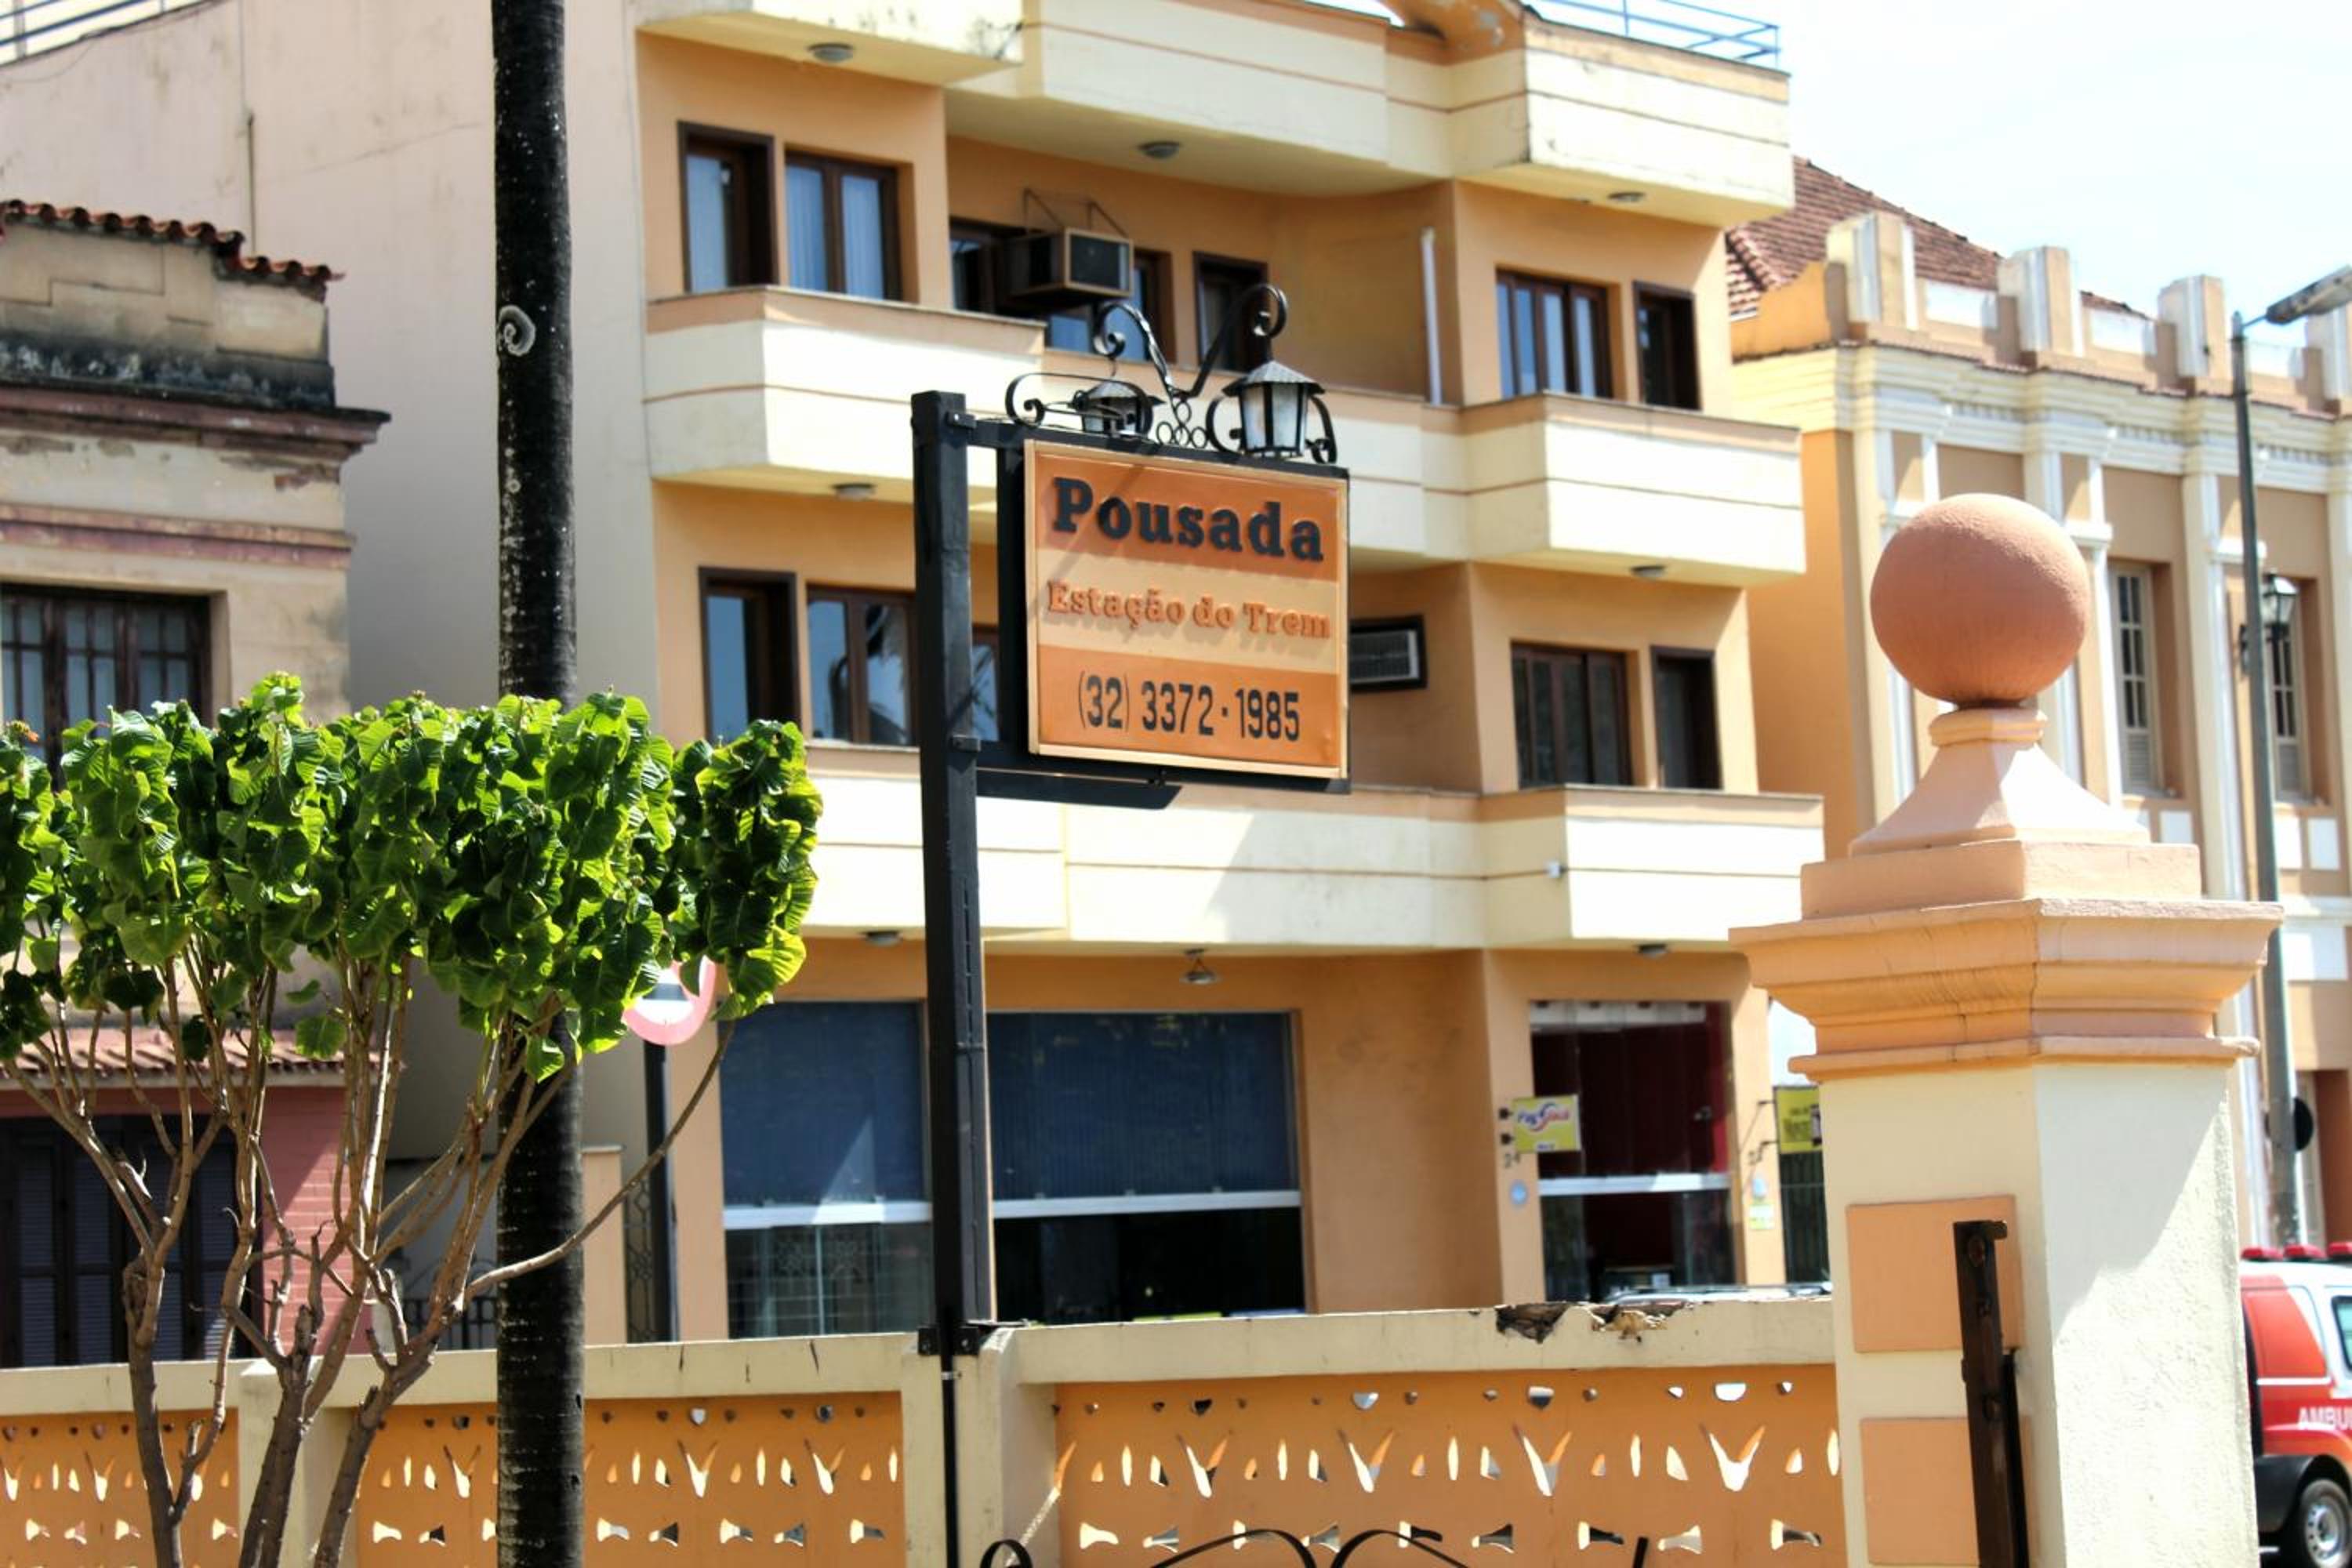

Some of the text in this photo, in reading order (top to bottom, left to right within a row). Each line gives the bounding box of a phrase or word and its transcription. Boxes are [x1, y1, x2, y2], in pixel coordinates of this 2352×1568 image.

[1053, 477, 1323, 561] Pousada
[1047, 580, 1330, 639] Estação do Trem
[1078, 670, 1130, 732] (32)
